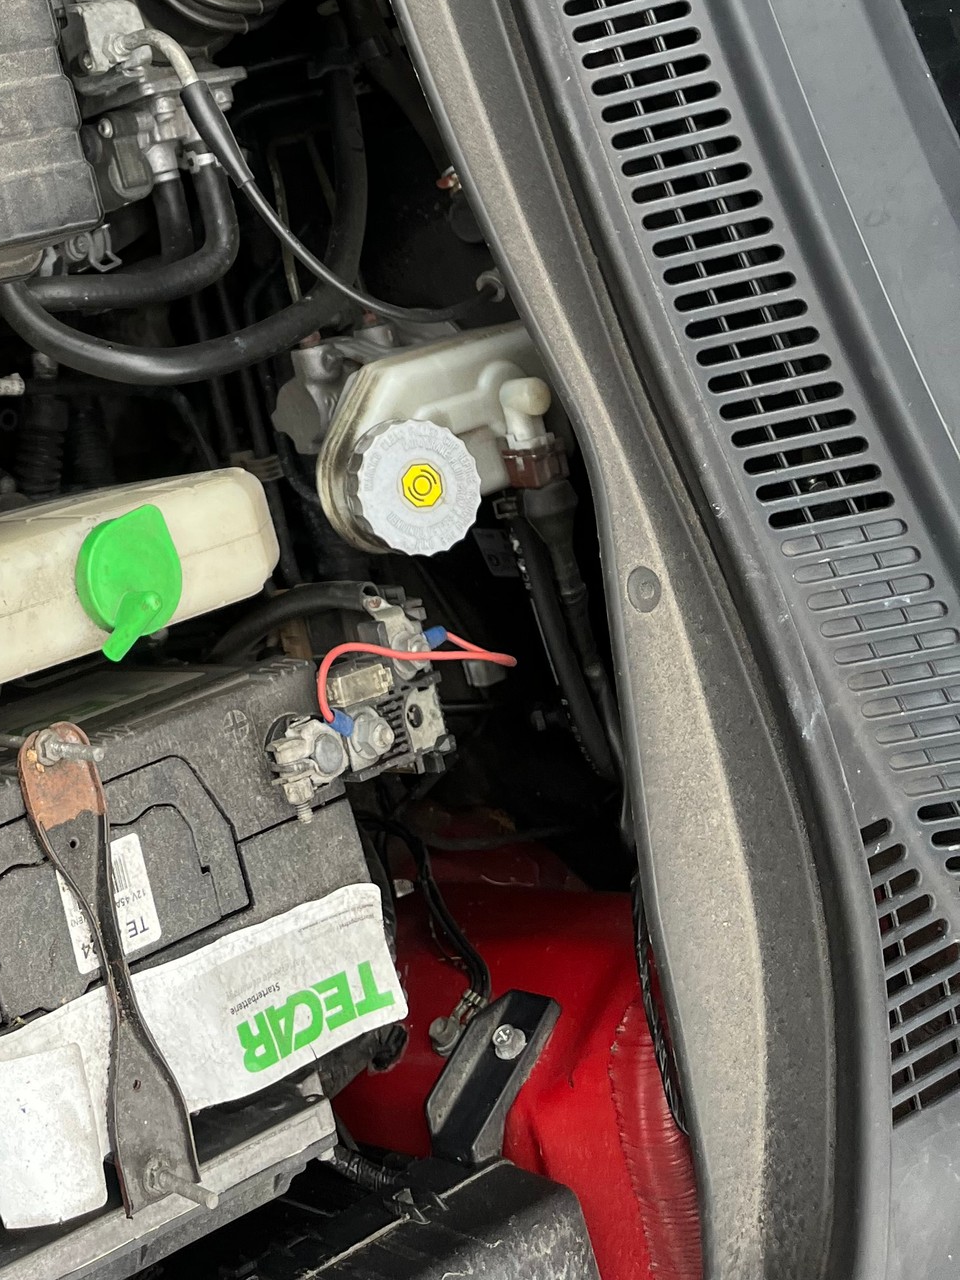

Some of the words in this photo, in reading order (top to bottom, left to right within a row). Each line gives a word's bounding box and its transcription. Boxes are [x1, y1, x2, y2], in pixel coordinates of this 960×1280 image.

[126, 916, 149, 938] TE
[230, 982, 280, 1015] Starterbatterie
[236, 960, 396, 1073] TECAR
